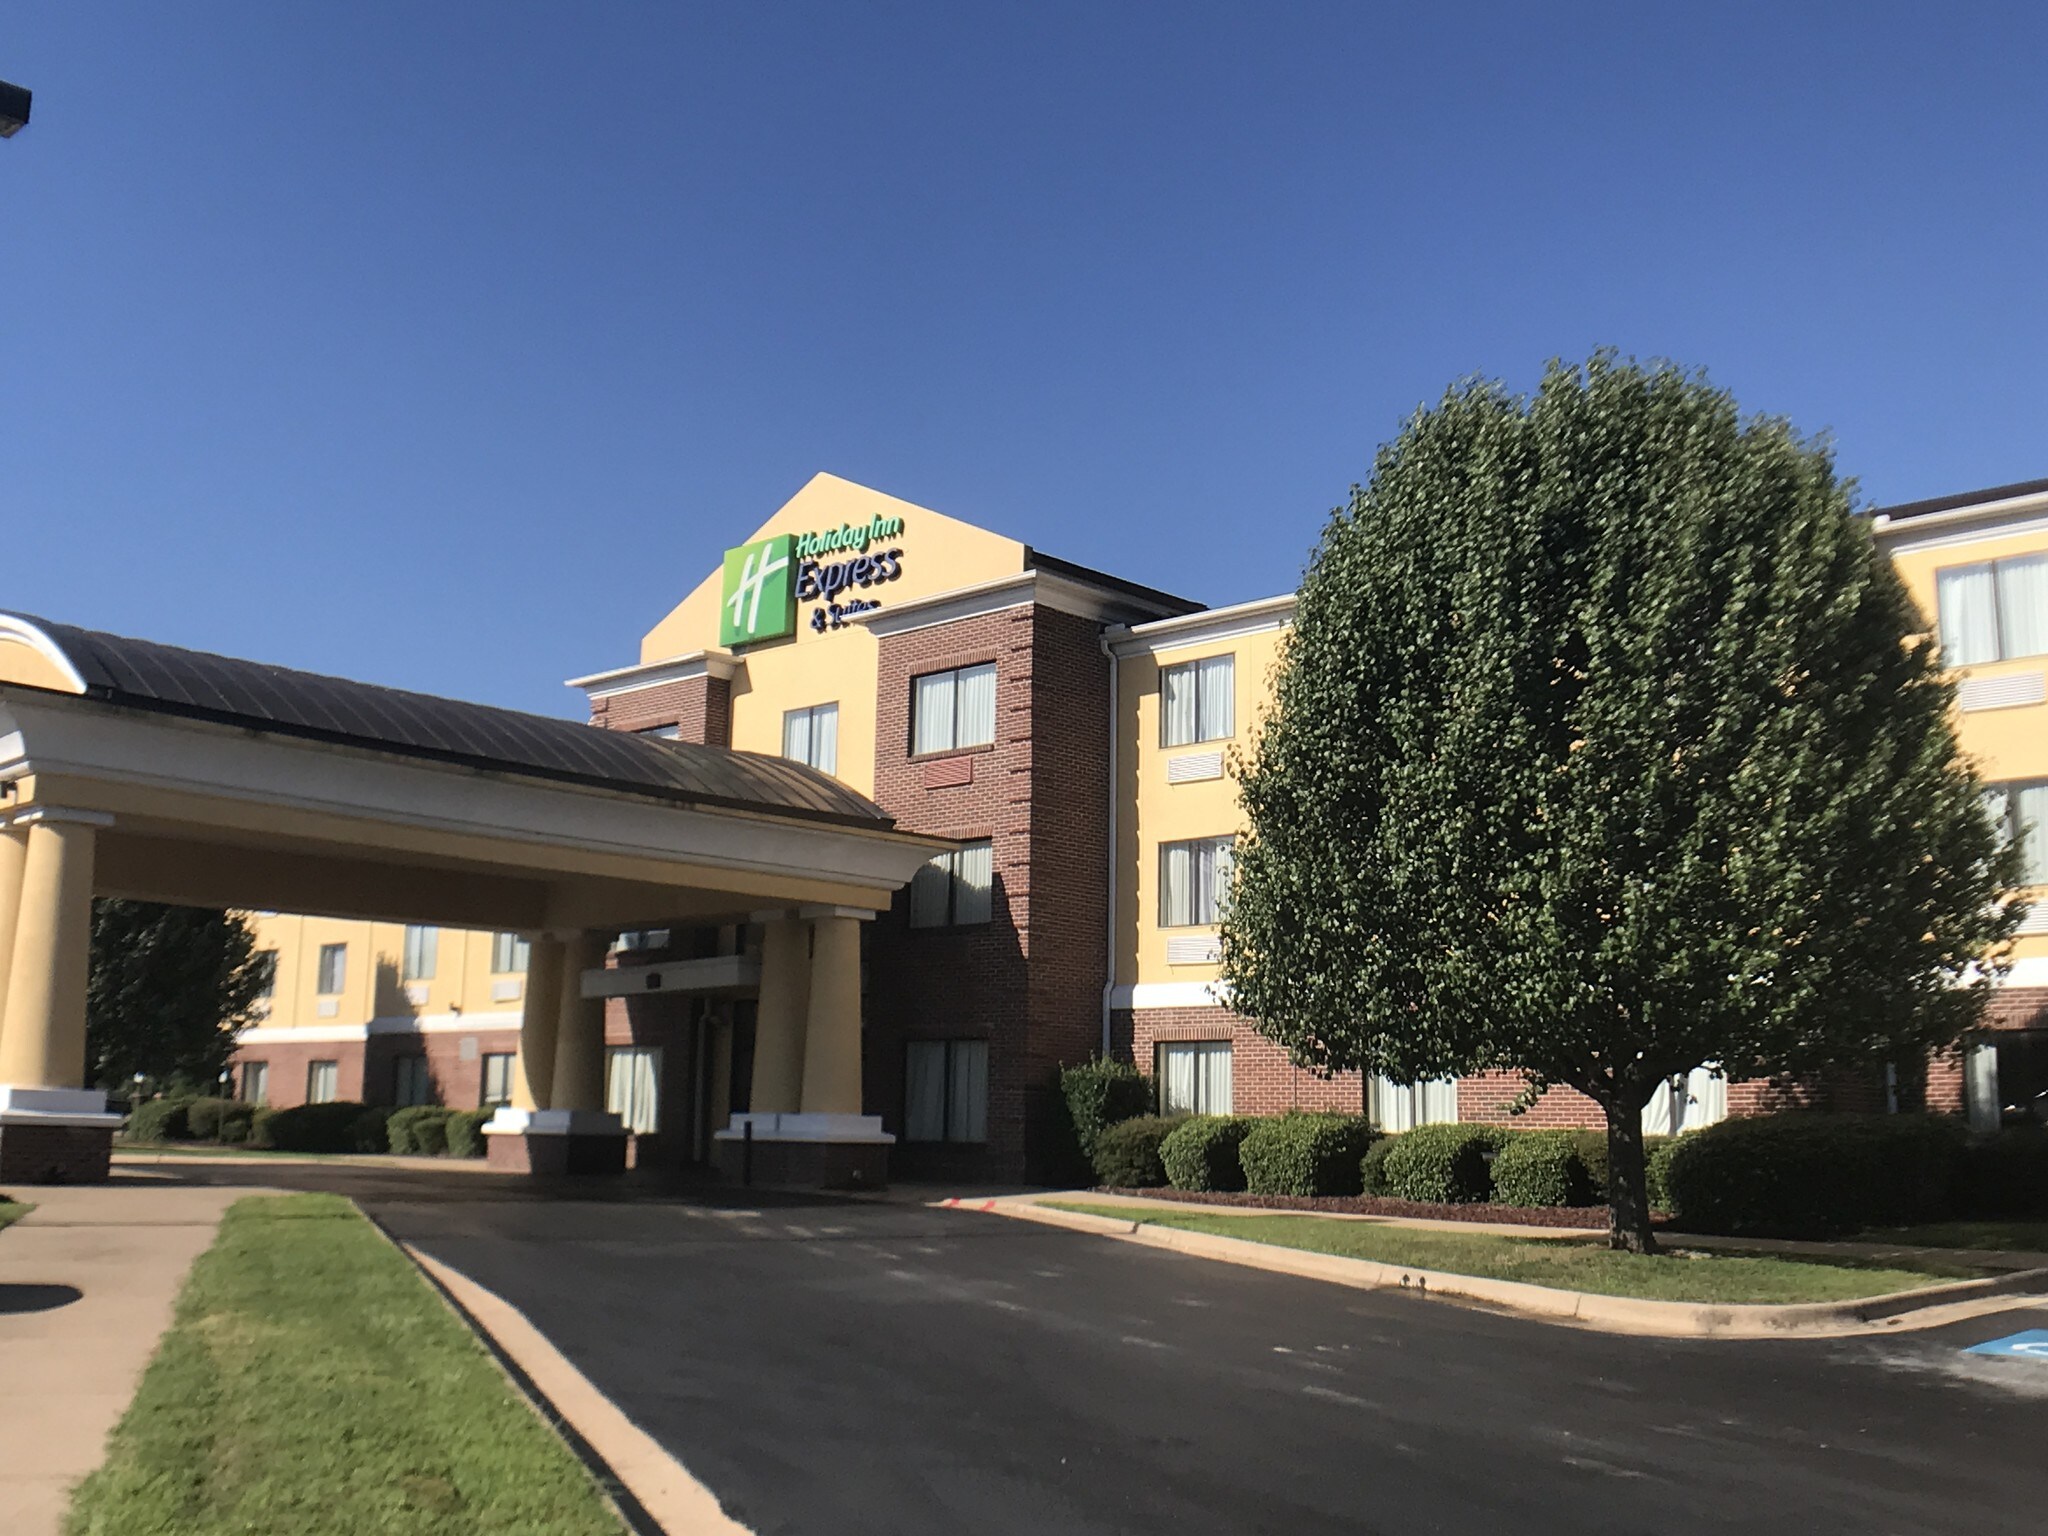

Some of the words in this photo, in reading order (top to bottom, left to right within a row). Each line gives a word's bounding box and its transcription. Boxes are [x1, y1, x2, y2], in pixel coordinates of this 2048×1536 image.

[795, 523, 869, 558] Holiday
[867, 513, 904, 541] Inn
[795, 548, 903, 602] Express
[810, 608, 826, 633] &
